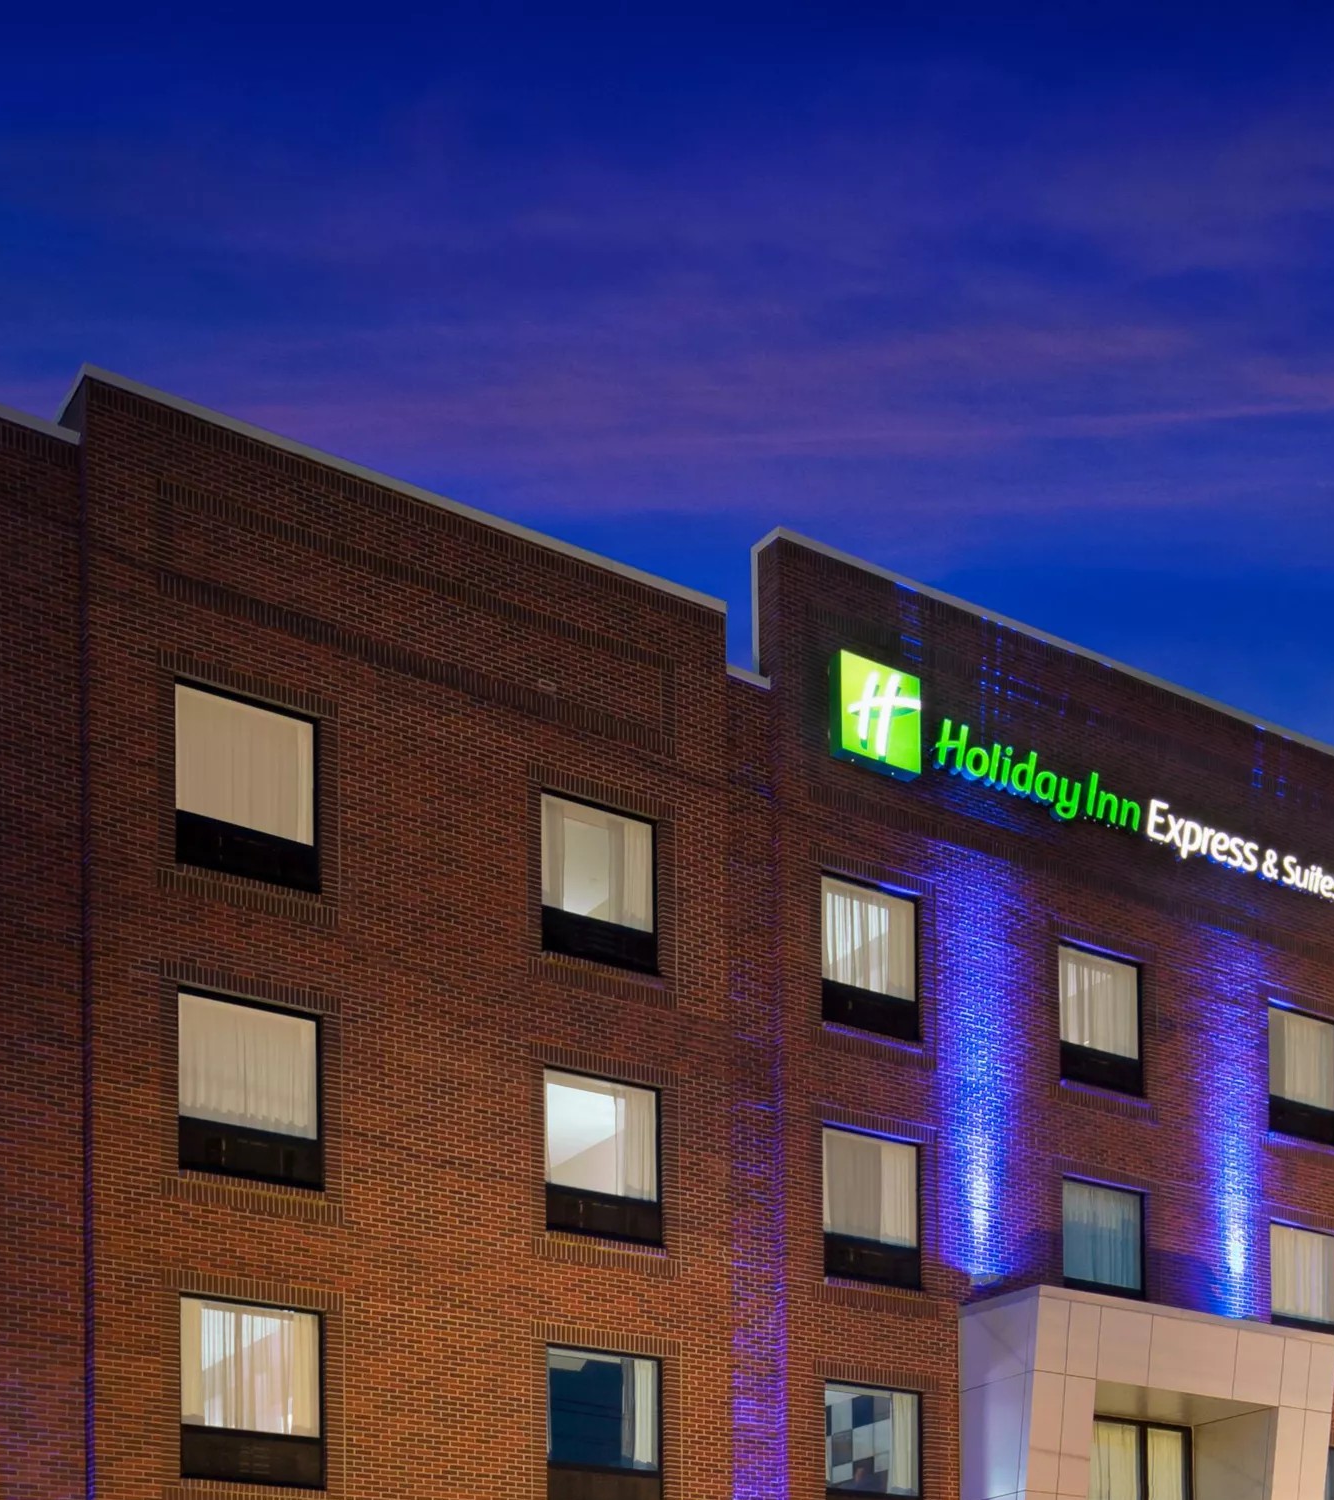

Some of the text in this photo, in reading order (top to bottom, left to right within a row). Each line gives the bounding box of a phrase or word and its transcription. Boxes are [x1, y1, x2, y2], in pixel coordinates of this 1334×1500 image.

[933, 718, 1081, 820] Holiday
[1088, 772, 1140, 832] Inn
[1146, 799, 1259, 873] Express
[1261, 848, 1279, 879] &
